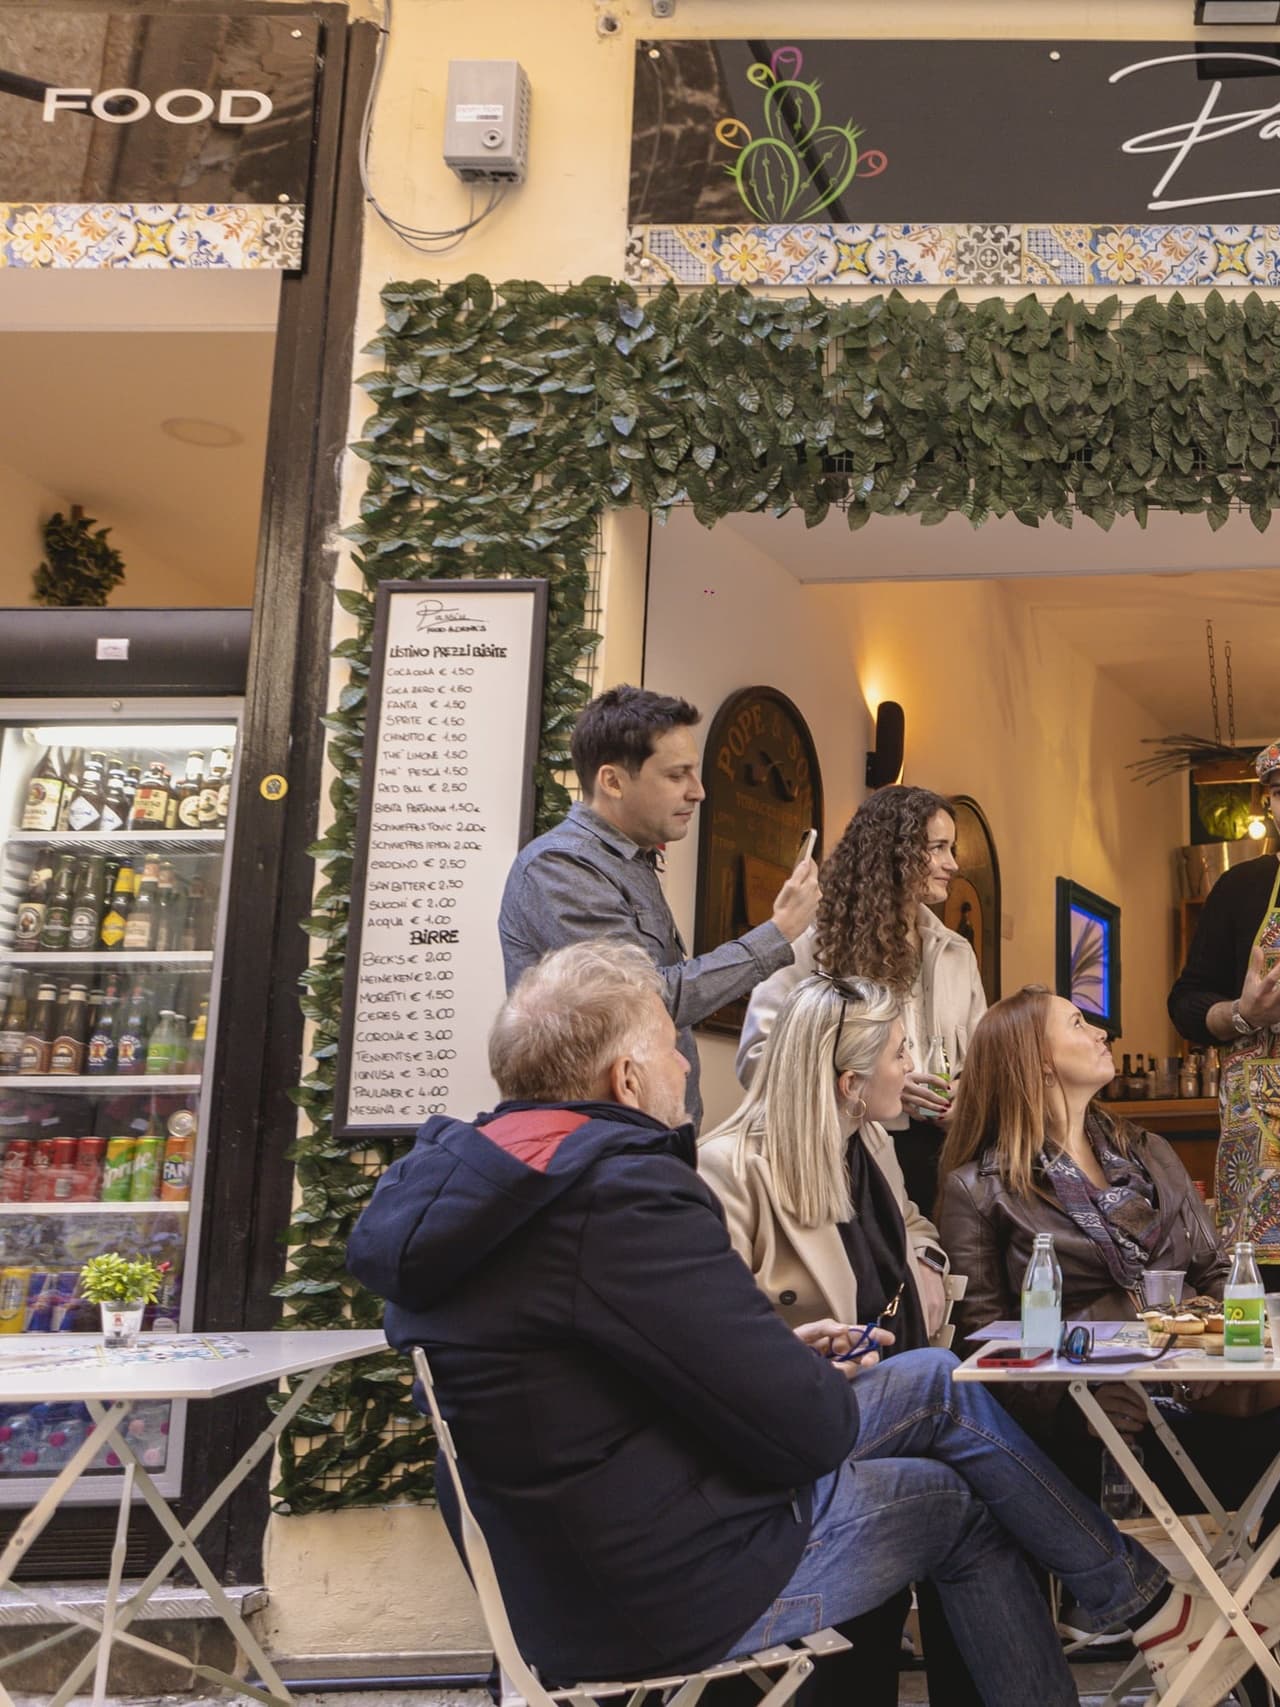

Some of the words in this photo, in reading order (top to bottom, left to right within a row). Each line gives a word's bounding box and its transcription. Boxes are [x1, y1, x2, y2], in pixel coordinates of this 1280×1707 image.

[42, 87, 273, 125] FOOD
[433, 643, 471, 658] PREZZI
[387, 700, 418, 709] FANTA
[385, 715, 422, 726] SPRITE
[406, 750, 439, 761] LIMONE
[407, 767, 441, 777] PESCA
[377, 782, 400, 793] RED
[403, 784, 423, 793] BULL
[409, 928, 460, 946] BIRRE
[360, 973, 413, 984] HEINEKEN
[359, 990, 407, 1004] MORETTI
[356, 1010, 401, 1023] CERES
[356, 1030, 404, 1042] CORONA
[349, 1104, 395, 1116] MESSINA
